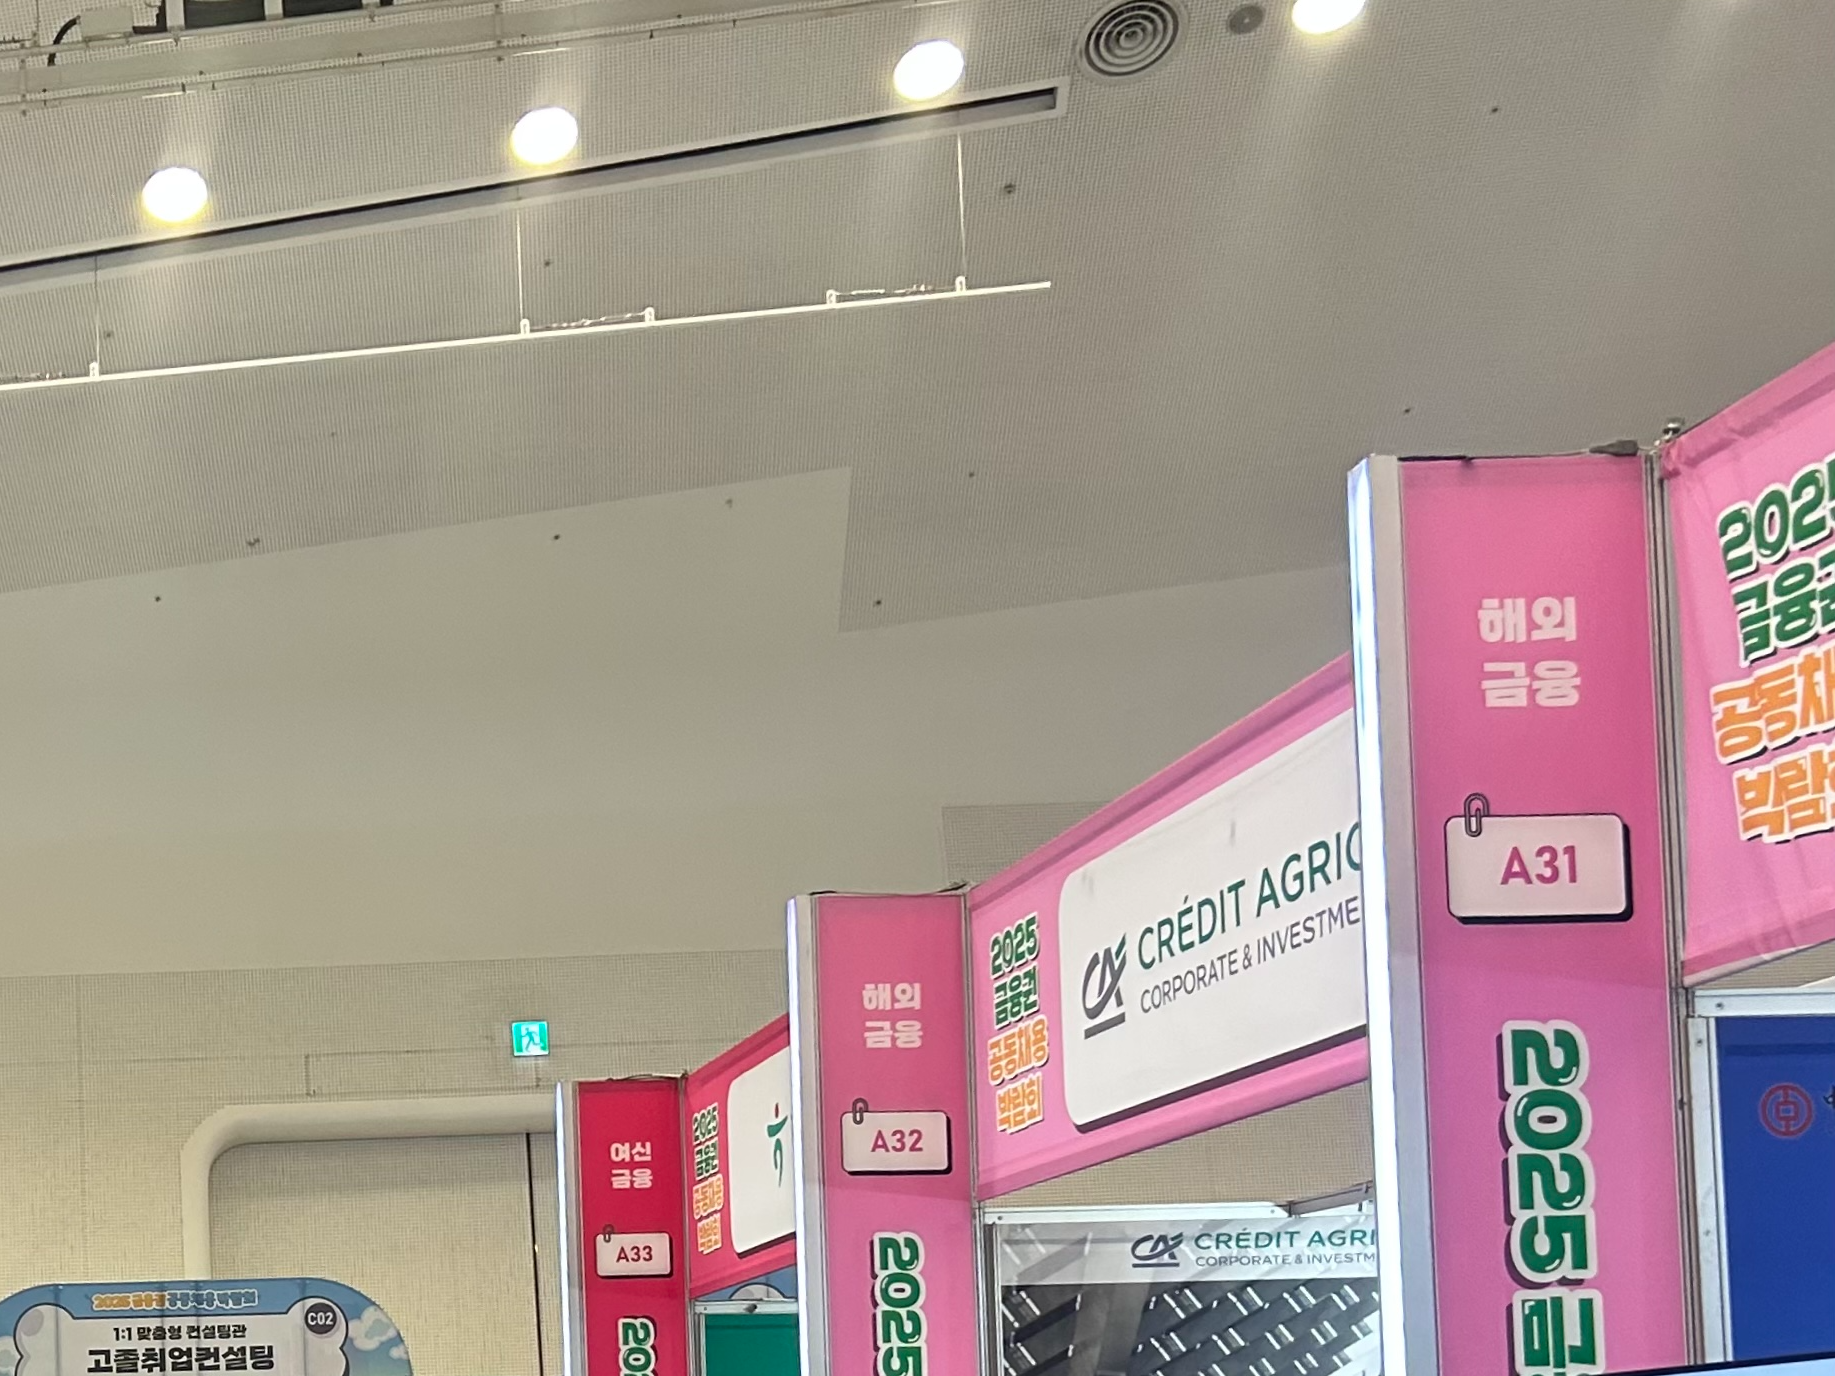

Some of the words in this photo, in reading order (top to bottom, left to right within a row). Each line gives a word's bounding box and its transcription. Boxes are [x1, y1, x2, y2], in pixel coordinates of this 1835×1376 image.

[1718, 457, 1835, 571] 202
[1477, 595, 1578, 643] 해외
[1480, 659, 1582, 710] 금융
[1712, 647, 1835, 758] 공동채
[1736, 749, 1835, 838] 박람
[1500, 843, 1579, 886] A31
[990, 914, 1039, 977] 2025
[1137, 879, 1246, 970] CRÉDIT
[861, 981, 922, 1011] 해외
[994, 964, 1039, 1027] 금융권
[1140, 948, 1239, 1014] CORPORATE
[1241, 943, 1253, 970] &
[862, 1020, 923, 1049] 금융
[988, 1016, 1048, 1082] 공동채용
[997, 1073, 1042, 1131] 박람회
[693, 1104, 719, 1144] 2025
[870, 1128, 924, 1153] A32
[609, 1141, 653, 1163] 여신
[1510, 1028, 1590, 1274] 2025
[609, 1167, 653, 1190] 금융
[615, 1244, 654, 1264] A33
[1194, 1227, 1301, 1250] CRÉDIT
[1195, 1253, 1292, 1267] CORPORATE
[1294, 1253, 1303, 1265] &
[113, 1326, 132, 1342] 1:1
[137, 1325, 183, 1341] 맞춤형
[186, 1323, 248, 1340] 컨설팅관
[307, 1311, 335, 1326] C02
[87, 1344, 275, 1374] 고졸취업컨설팅
